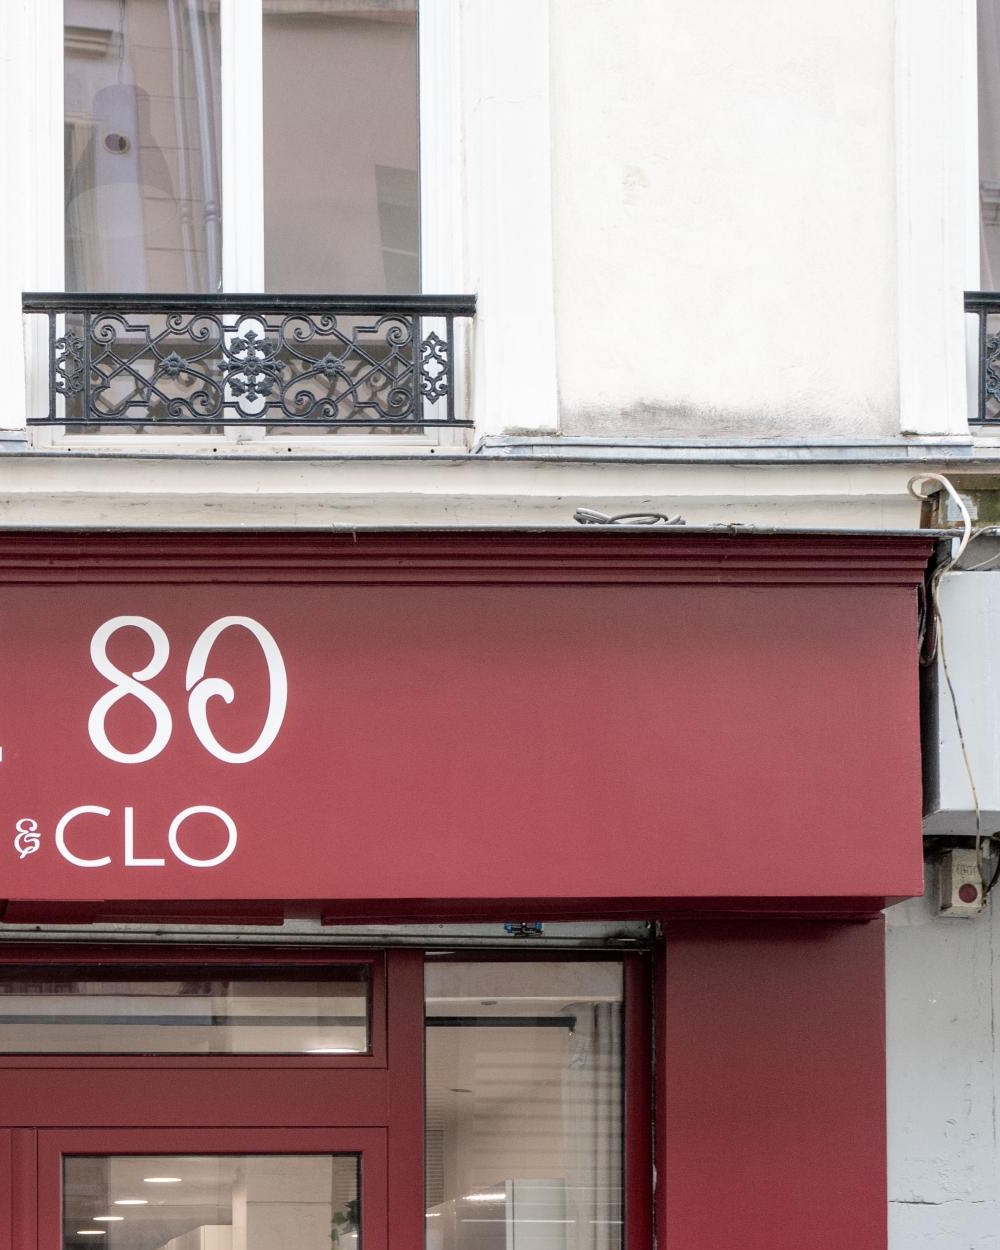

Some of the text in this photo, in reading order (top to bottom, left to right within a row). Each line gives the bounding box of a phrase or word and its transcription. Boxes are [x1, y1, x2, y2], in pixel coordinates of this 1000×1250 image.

[88, 615, 288, 764] 80
[13, 818, 41, 859] &
[55, 805, 238, 867] CLO
